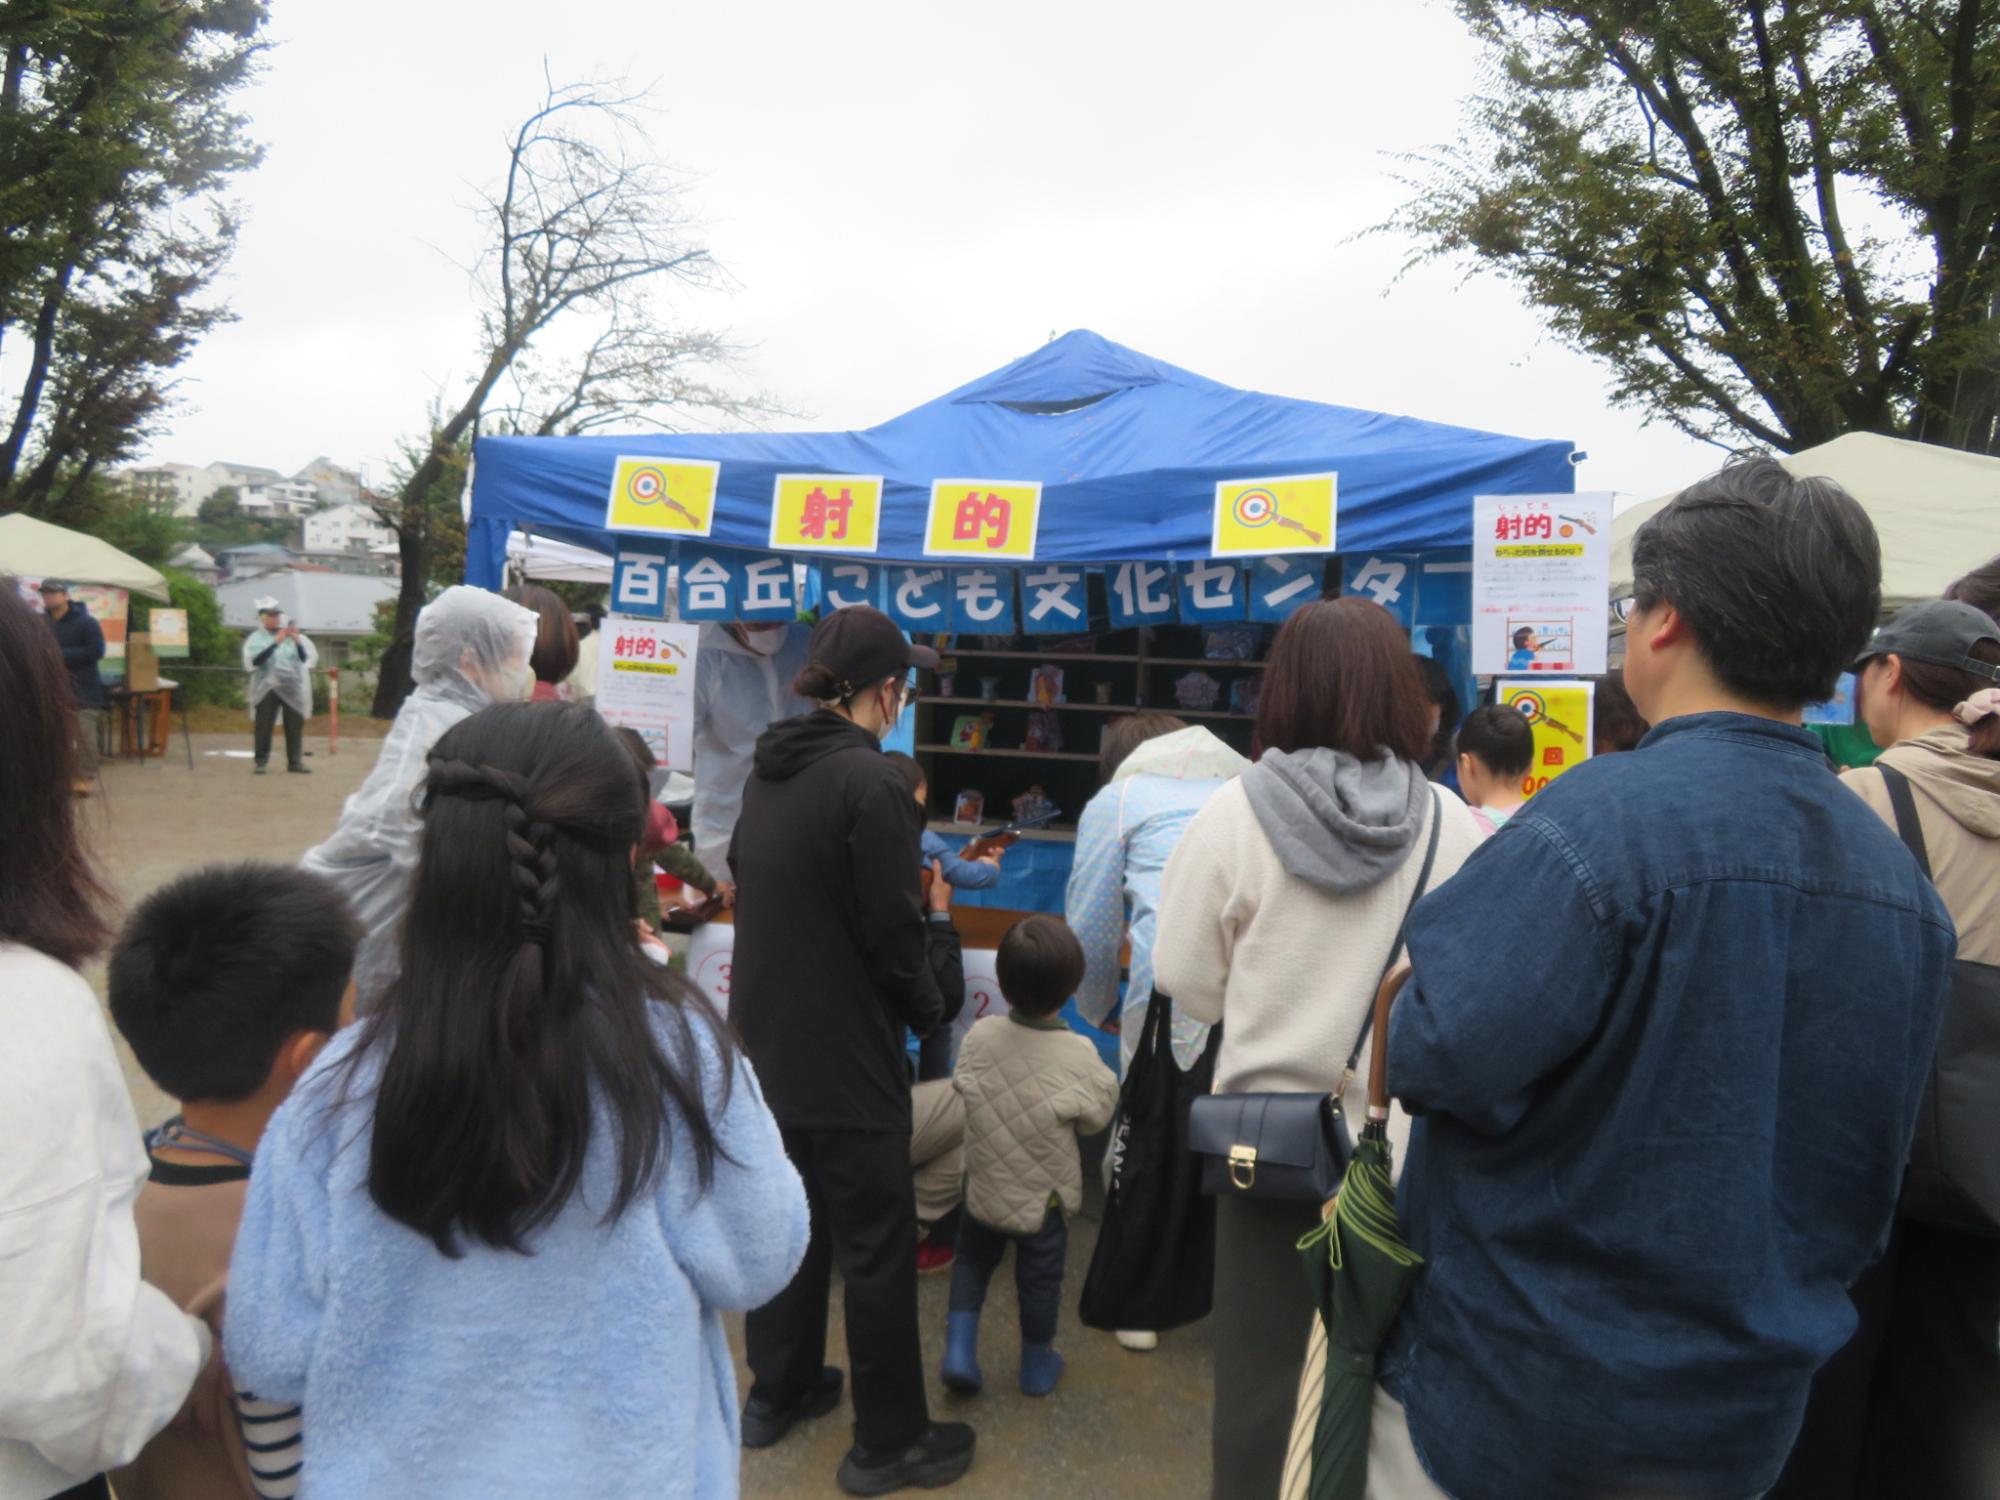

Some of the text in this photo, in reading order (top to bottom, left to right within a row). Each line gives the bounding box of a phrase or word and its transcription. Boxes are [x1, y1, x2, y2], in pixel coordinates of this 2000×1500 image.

[800, 487, 1011, 548] 射 的
[1495, 513, 1552, 540] 射的
[614, 635, 656, 658] 射的
